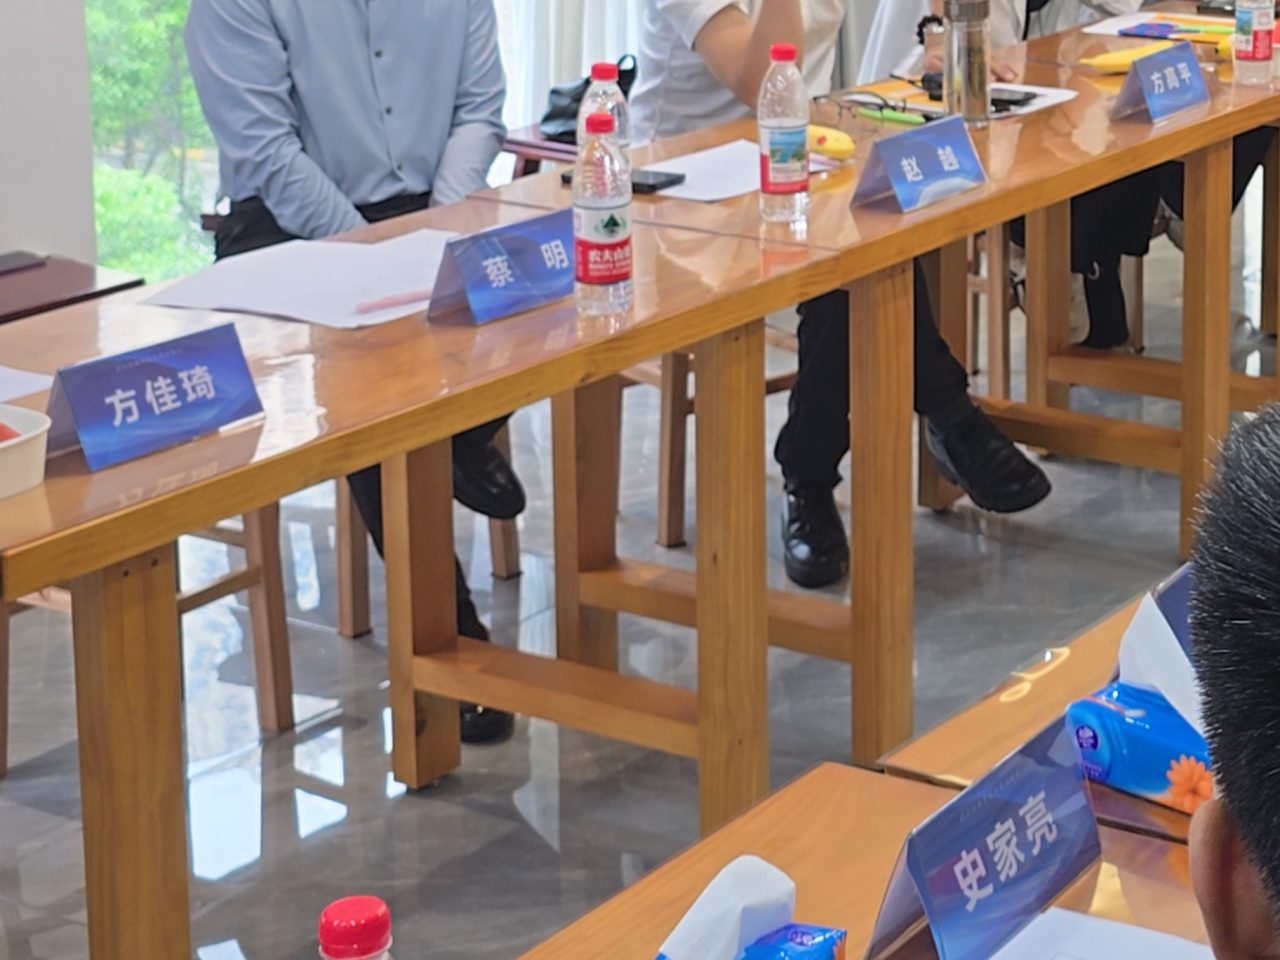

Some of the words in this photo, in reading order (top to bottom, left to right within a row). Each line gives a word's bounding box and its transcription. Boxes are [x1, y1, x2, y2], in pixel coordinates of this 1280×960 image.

[104, 365, 216, 428] 方佳琦
[953, 790, 1058, 913] 史家亮
